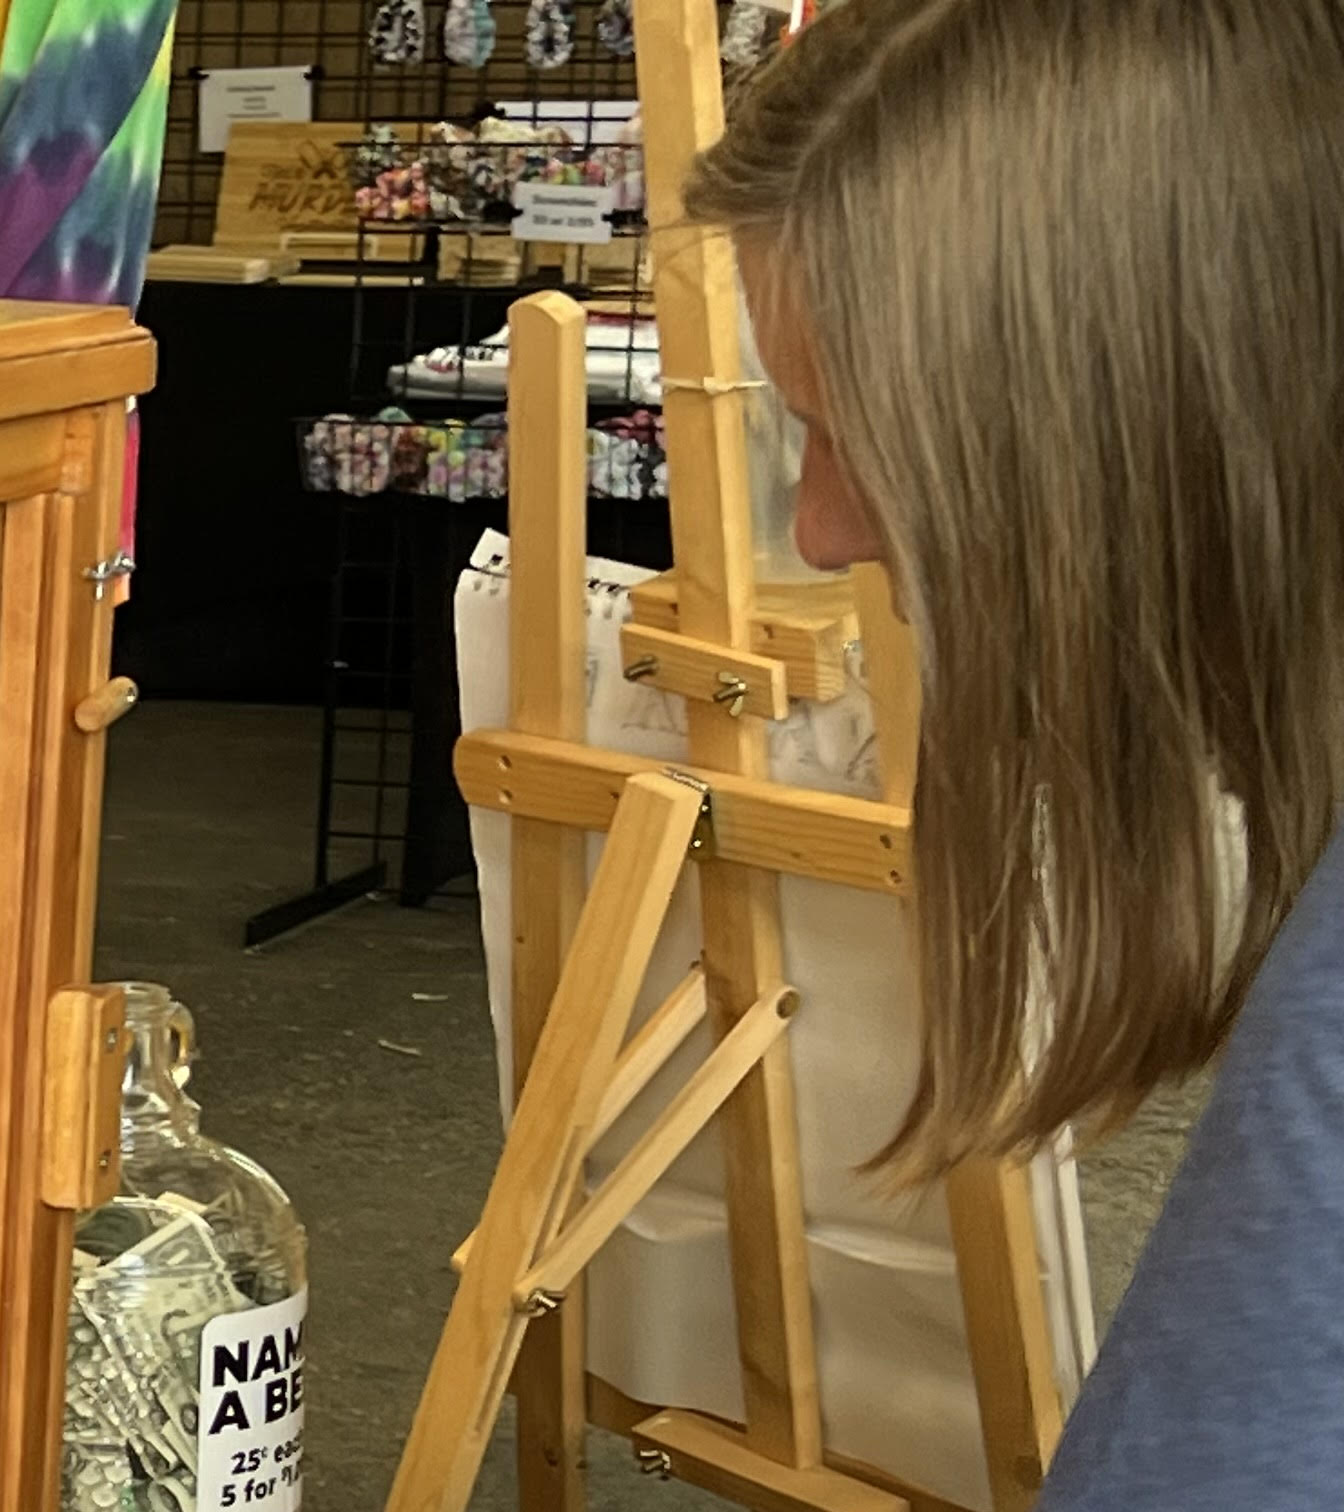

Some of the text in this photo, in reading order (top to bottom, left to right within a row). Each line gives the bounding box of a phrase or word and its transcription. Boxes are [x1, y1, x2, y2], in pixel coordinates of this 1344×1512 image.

[212, 1321, 303, 1387] NAM
[208, 1368, 303, 1435] A BE
[231, 1446, 268, 1475] 25¢
[220, 1484, 236, 1507] 5
[243, 1477, 277, 1503] for
